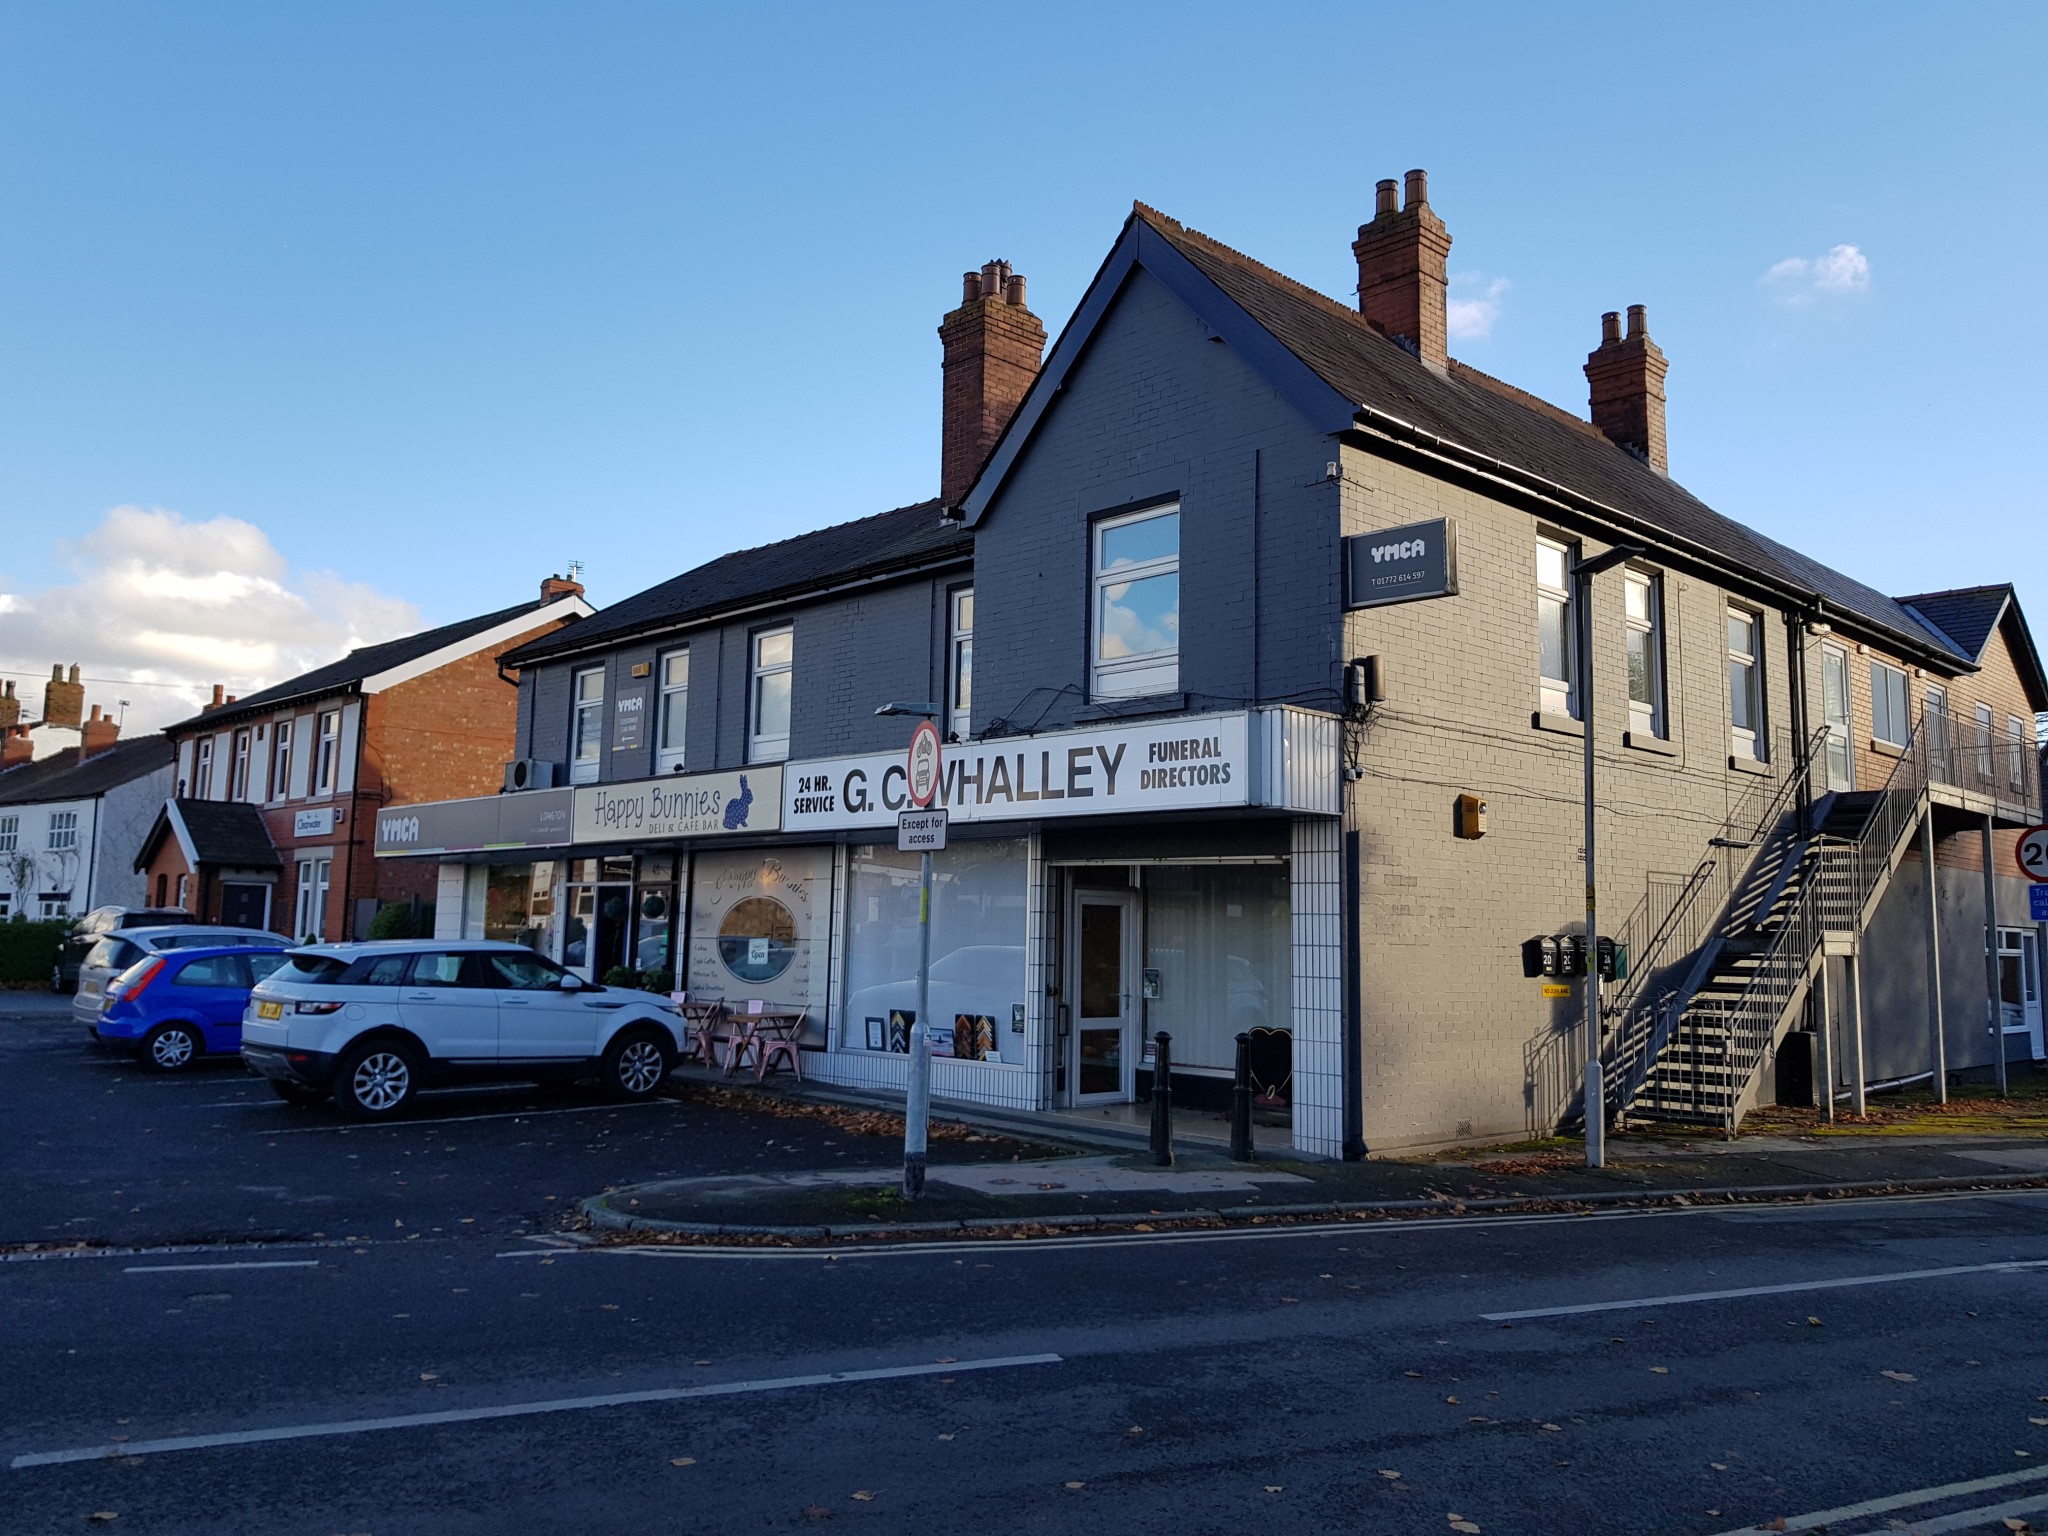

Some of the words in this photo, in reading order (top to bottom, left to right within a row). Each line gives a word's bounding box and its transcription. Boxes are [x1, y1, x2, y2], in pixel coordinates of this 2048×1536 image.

[1371, 538, 1425, 563] YMCA
[1376, 576, 1397, 585] 01772
[1398, 573, 1411, 582] 614
[1412, 570, 1425, 580] 597
[618, 696, 643, 712] YMCA
[1149, 736, 1222, 763] FUNERAL
[798, 776, 811, 793] 24
[814, 775, 832, 792] HR.
[1140, 762, 1231, 790] DIRECTORS
[843, 768, 874, 814] G.
[595, 790, 644, 829] Happy
[650, 786, 721, 819] Bunnies
[793, 795, 835, 815] SERVICE
[540, 810, 566, 821] LONGTON
[901, 817, 929, 831] Except
[931, 816, 943, 828] for
[382, 815, 419, 842] YMCA
[649, 823, 665, 834] DELI
[668, 824, 674, 833] &
[677, 820, 699, 832] CAFE
[702, 819, 719, 831] BAR
[908, 834, 935, 844] access
[2024, 842, 2048, 867] 2
[1543, 954, 1552, 965] 2D
[1563, 954, 1571, 965] 2C
